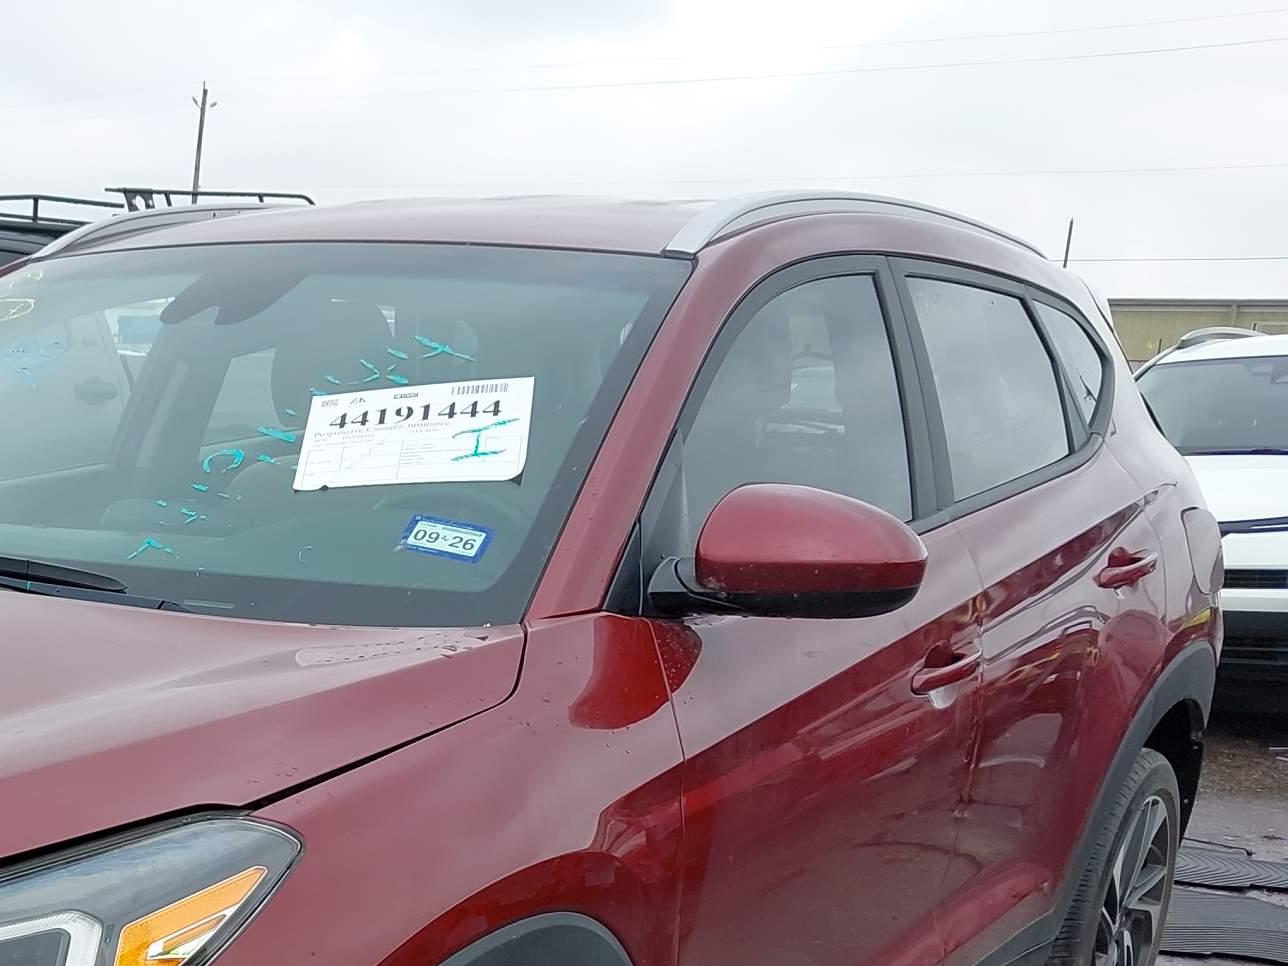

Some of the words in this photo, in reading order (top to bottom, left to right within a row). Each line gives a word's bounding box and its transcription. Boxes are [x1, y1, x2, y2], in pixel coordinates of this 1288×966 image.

[329, 399, 502, 429] 44191444
[413, 529, 440, 544] 09
[448, 535, 476, 551] 26
